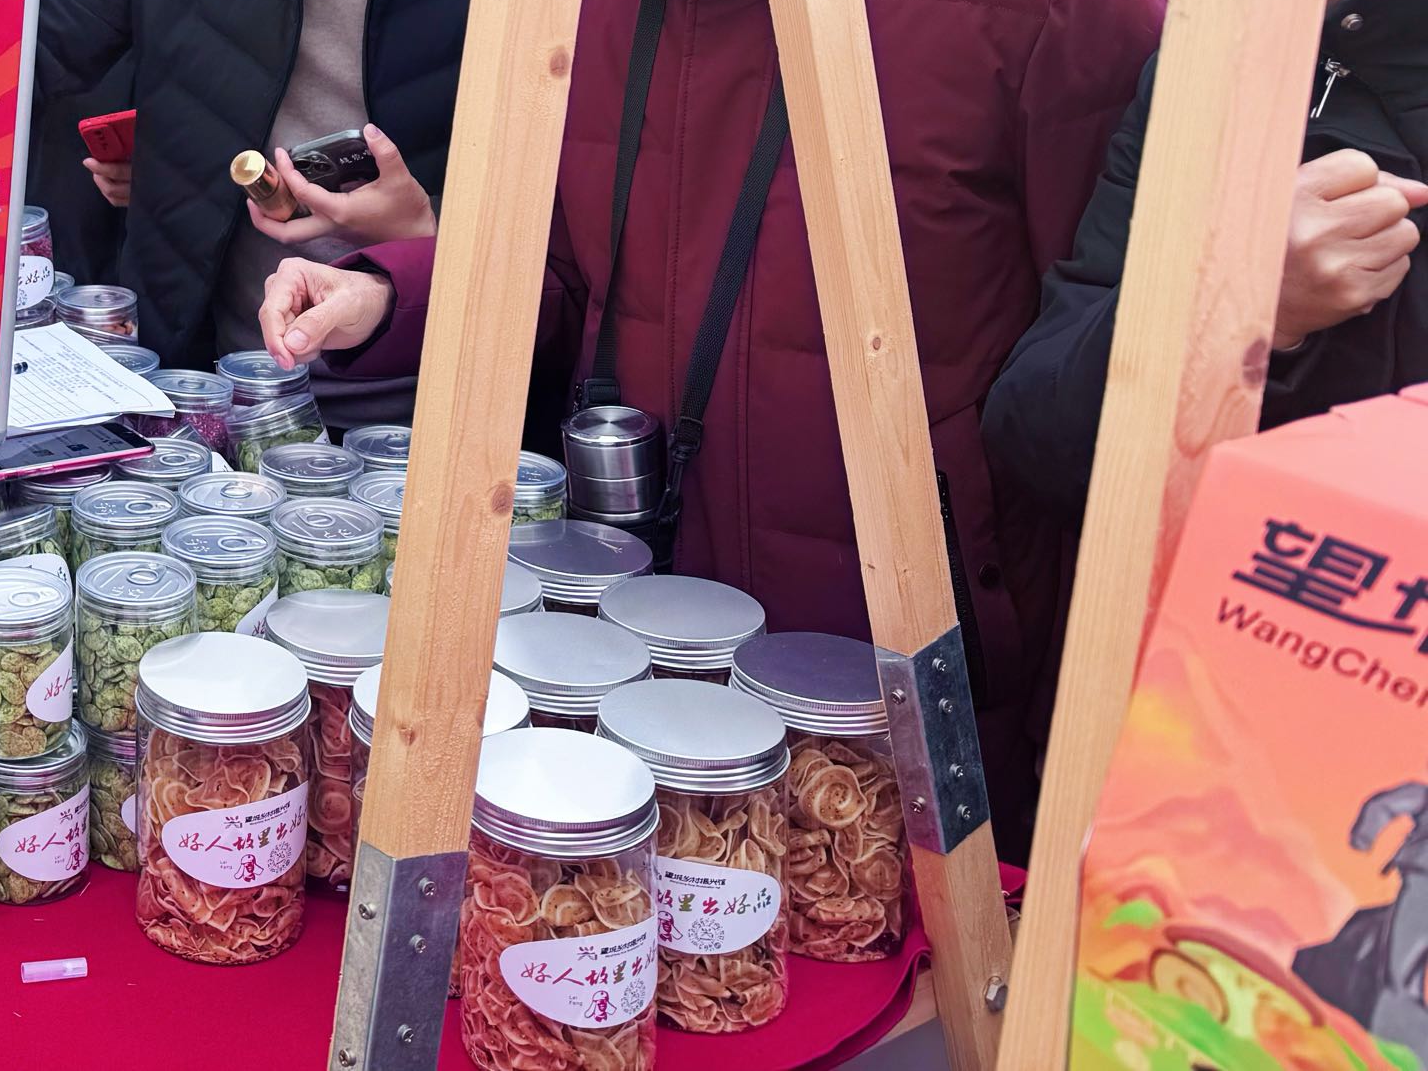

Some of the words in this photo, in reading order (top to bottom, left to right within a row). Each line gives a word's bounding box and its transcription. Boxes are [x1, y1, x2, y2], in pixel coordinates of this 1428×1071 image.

[178, 800, 308, 852] 好人故里出好
